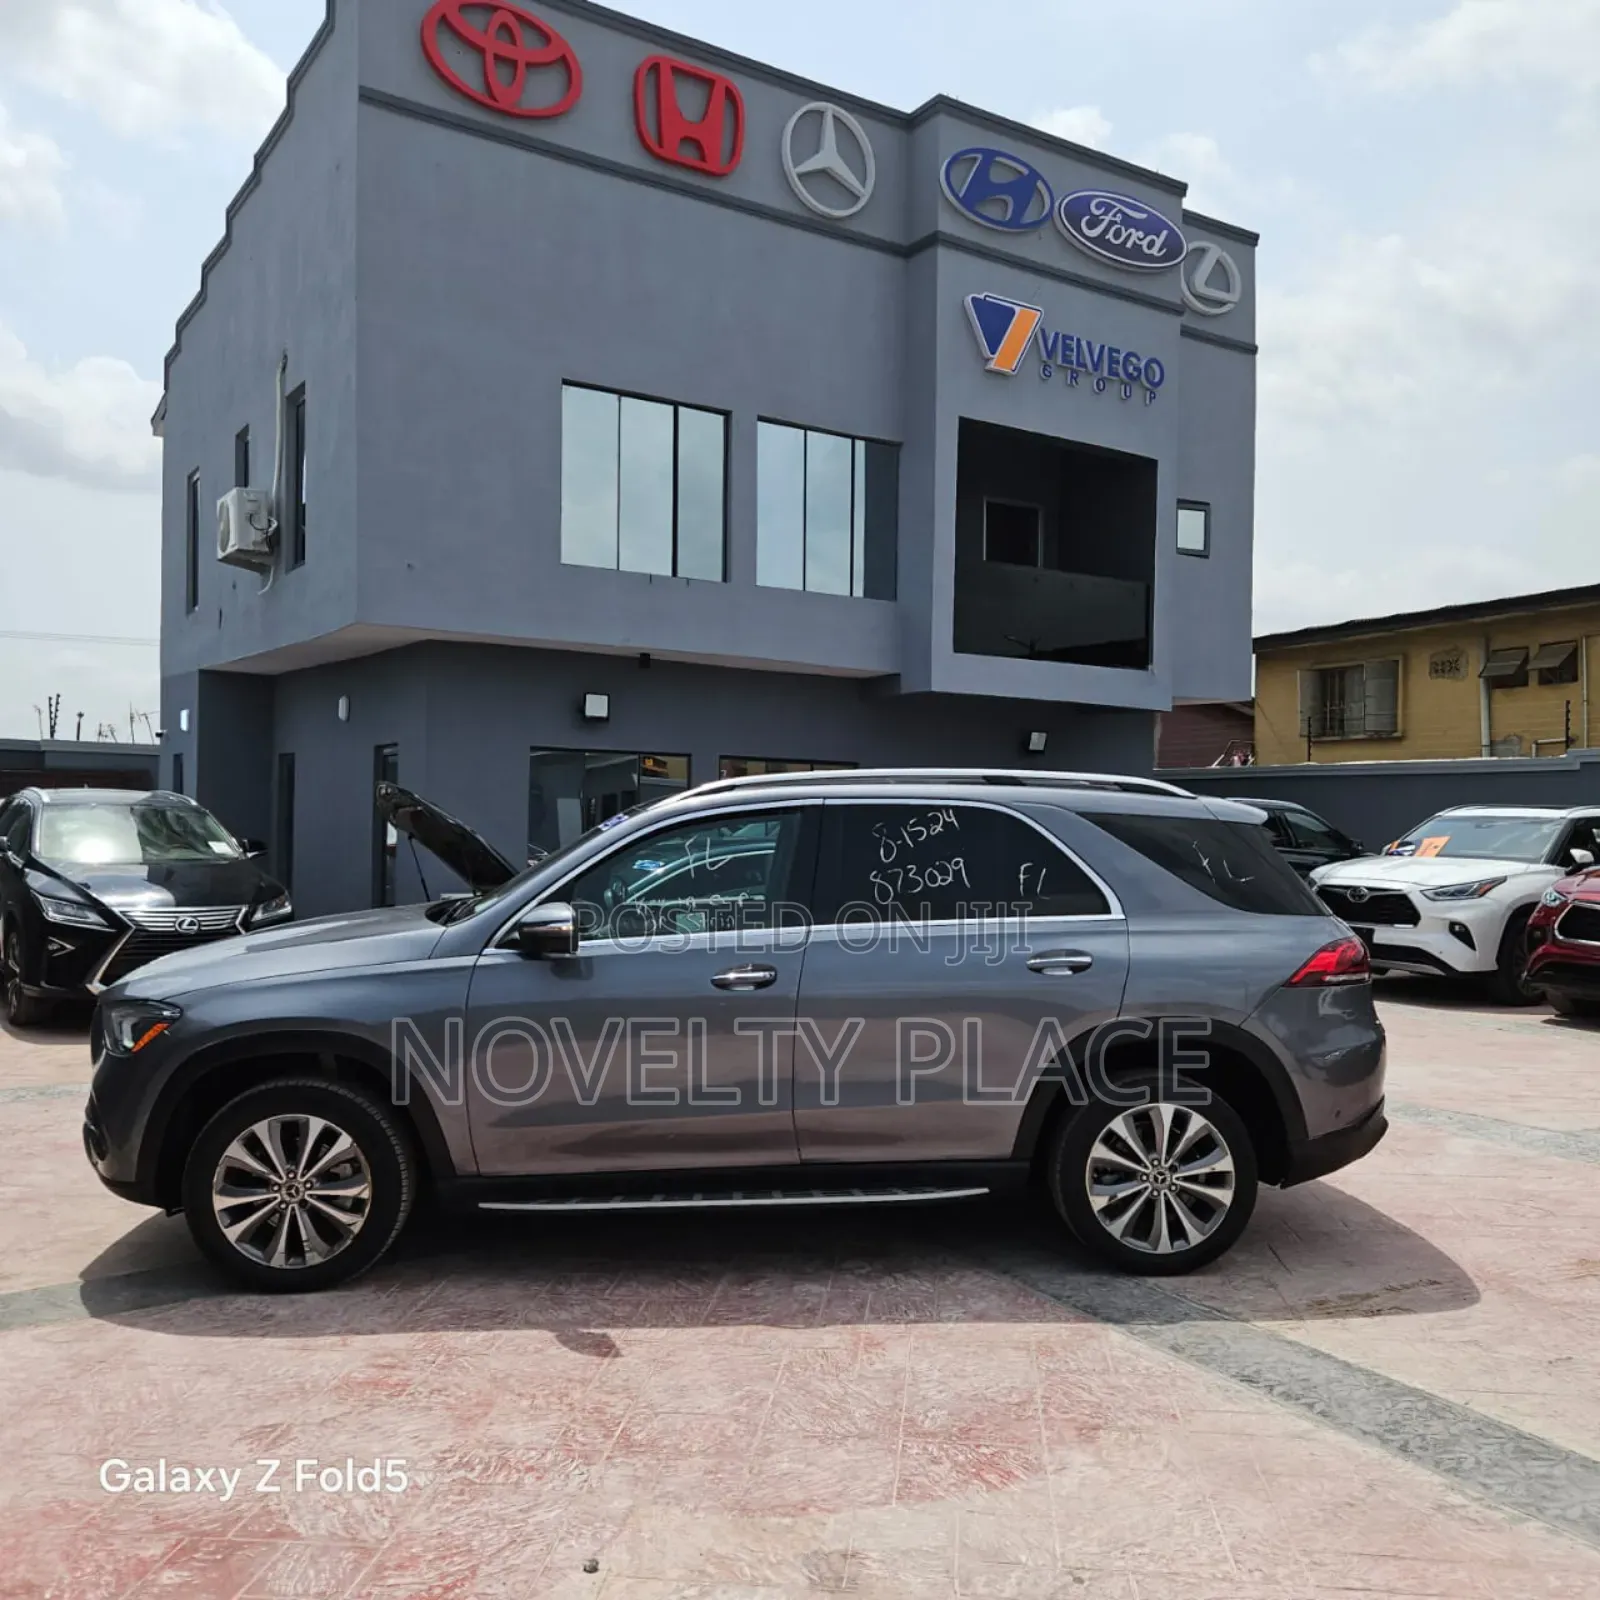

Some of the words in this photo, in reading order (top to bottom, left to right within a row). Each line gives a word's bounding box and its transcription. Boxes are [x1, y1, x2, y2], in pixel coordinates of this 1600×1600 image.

[1080, 197, 1168, 257] Ford
[1037, 326, 1165, 389] VELVEGO
[1039, 362, 1157, 406] GROUP
[869, 856, 971, 905] 873029
